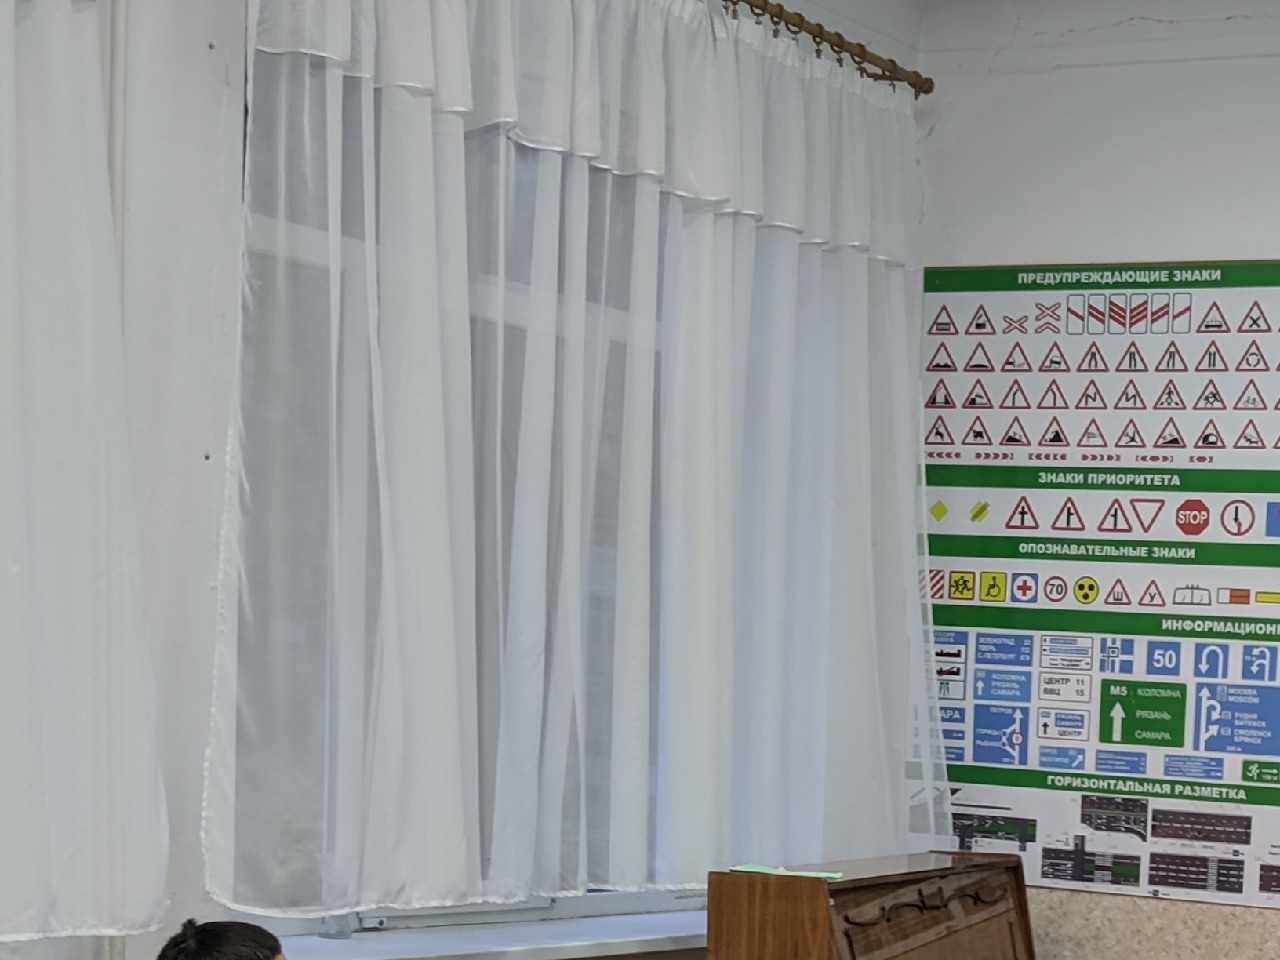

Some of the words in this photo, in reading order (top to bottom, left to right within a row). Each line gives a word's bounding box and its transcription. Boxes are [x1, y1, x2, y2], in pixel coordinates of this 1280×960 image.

[1018, 270, 1170, 285] ПРЕДУПРЕЖДАЮЩИЕ
[1173, 269, 1221, 282] ЗНАКИ
[1038, 472, 1084, 485] ЗНАКИ
[1087, 473, 1181, 487] ПРИОРИТЕТА
[1177, 510, 1208, 525] STOP
[1019, 543, 1149, 558] ОПОЗНАВАТЕЛЬНЫЕ
[1151, 547, 1196, 559] ЗНАКИ
[1048, 583, 1064, 596] 70
[1152, 649, 1177, 669] 50
[1110, 684, 1128, 697] М5
[1047, 775, 1172, 796] ГОРИЗОНТАЛЬНАЯ
[1174, 782, 1247, 800] РАЗМЕТКА
